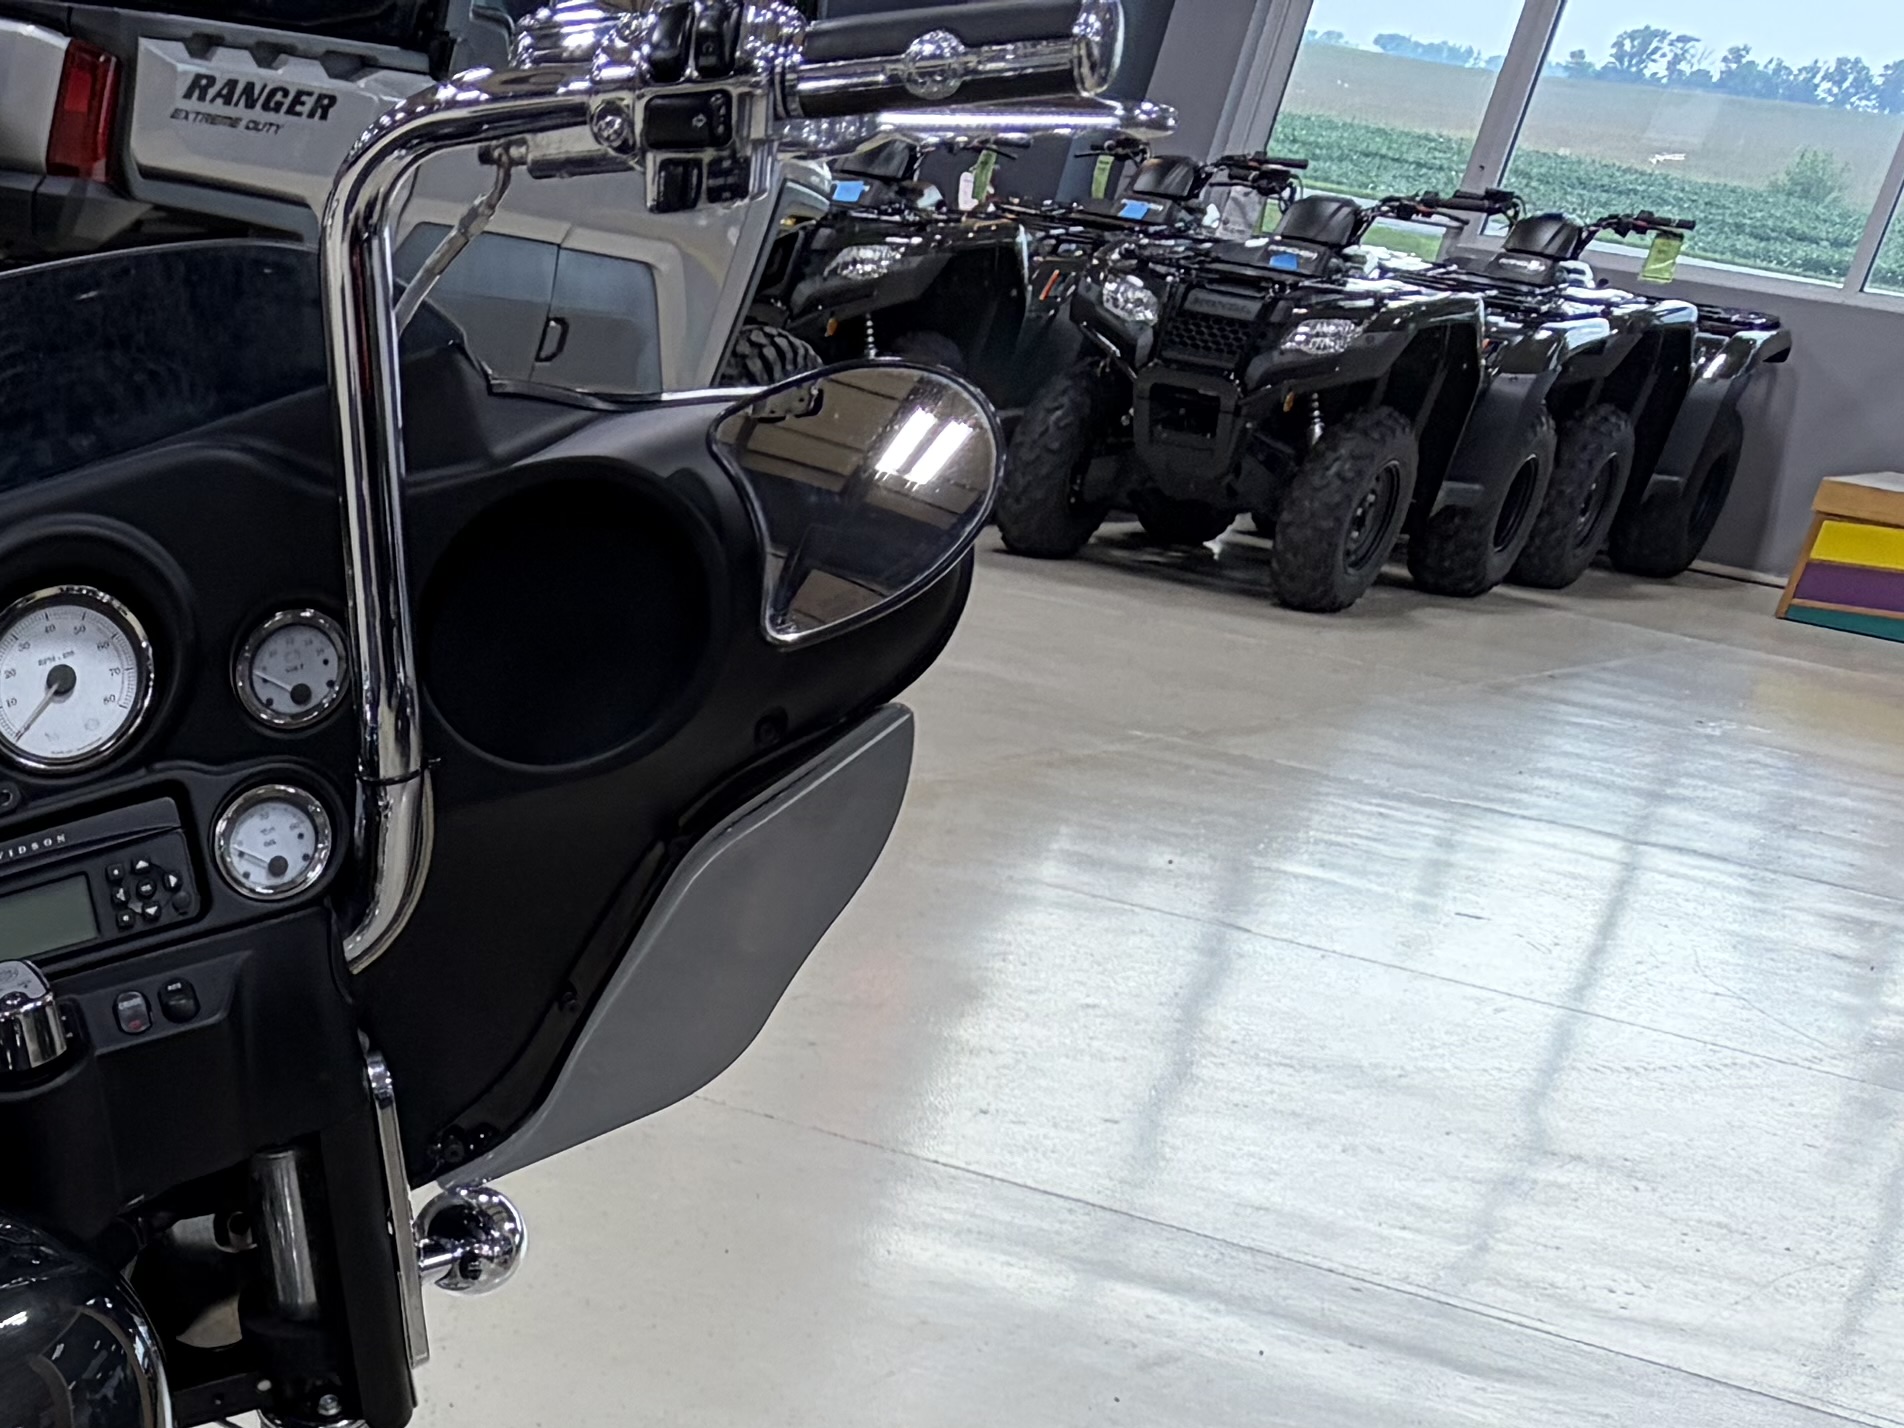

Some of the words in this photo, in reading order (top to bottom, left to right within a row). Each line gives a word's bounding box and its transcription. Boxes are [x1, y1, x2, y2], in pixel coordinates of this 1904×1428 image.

[182, 72, 338, 121] RANGER
[169, 107, 243, 128] EXTREME
[244, 119, 285, 135] DUTY
